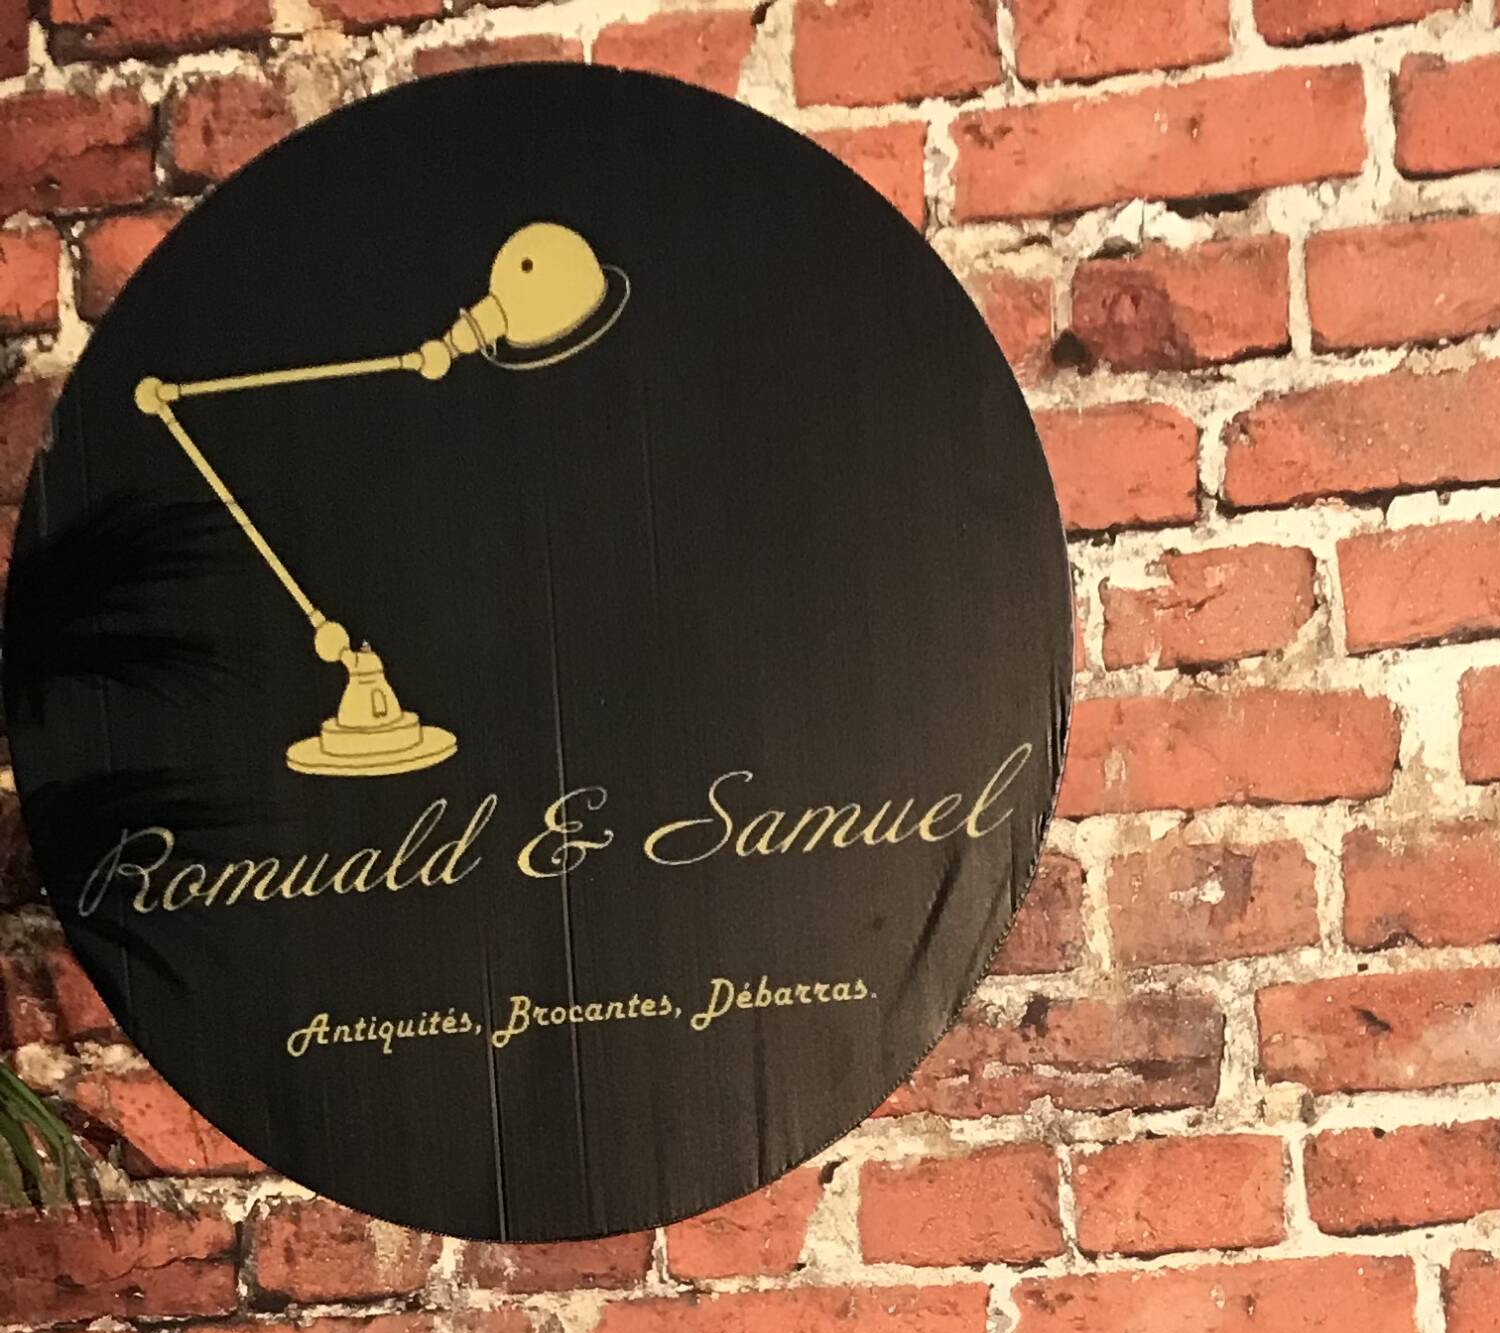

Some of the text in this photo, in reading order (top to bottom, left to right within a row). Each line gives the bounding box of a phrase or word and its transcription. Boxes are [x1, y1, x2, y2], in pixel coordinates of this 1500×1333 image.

[77, 742, 1034, 917] Romuald & Samuel
[287, 977, 877, 1058] Antiquités, Brocantes, Débarras.
